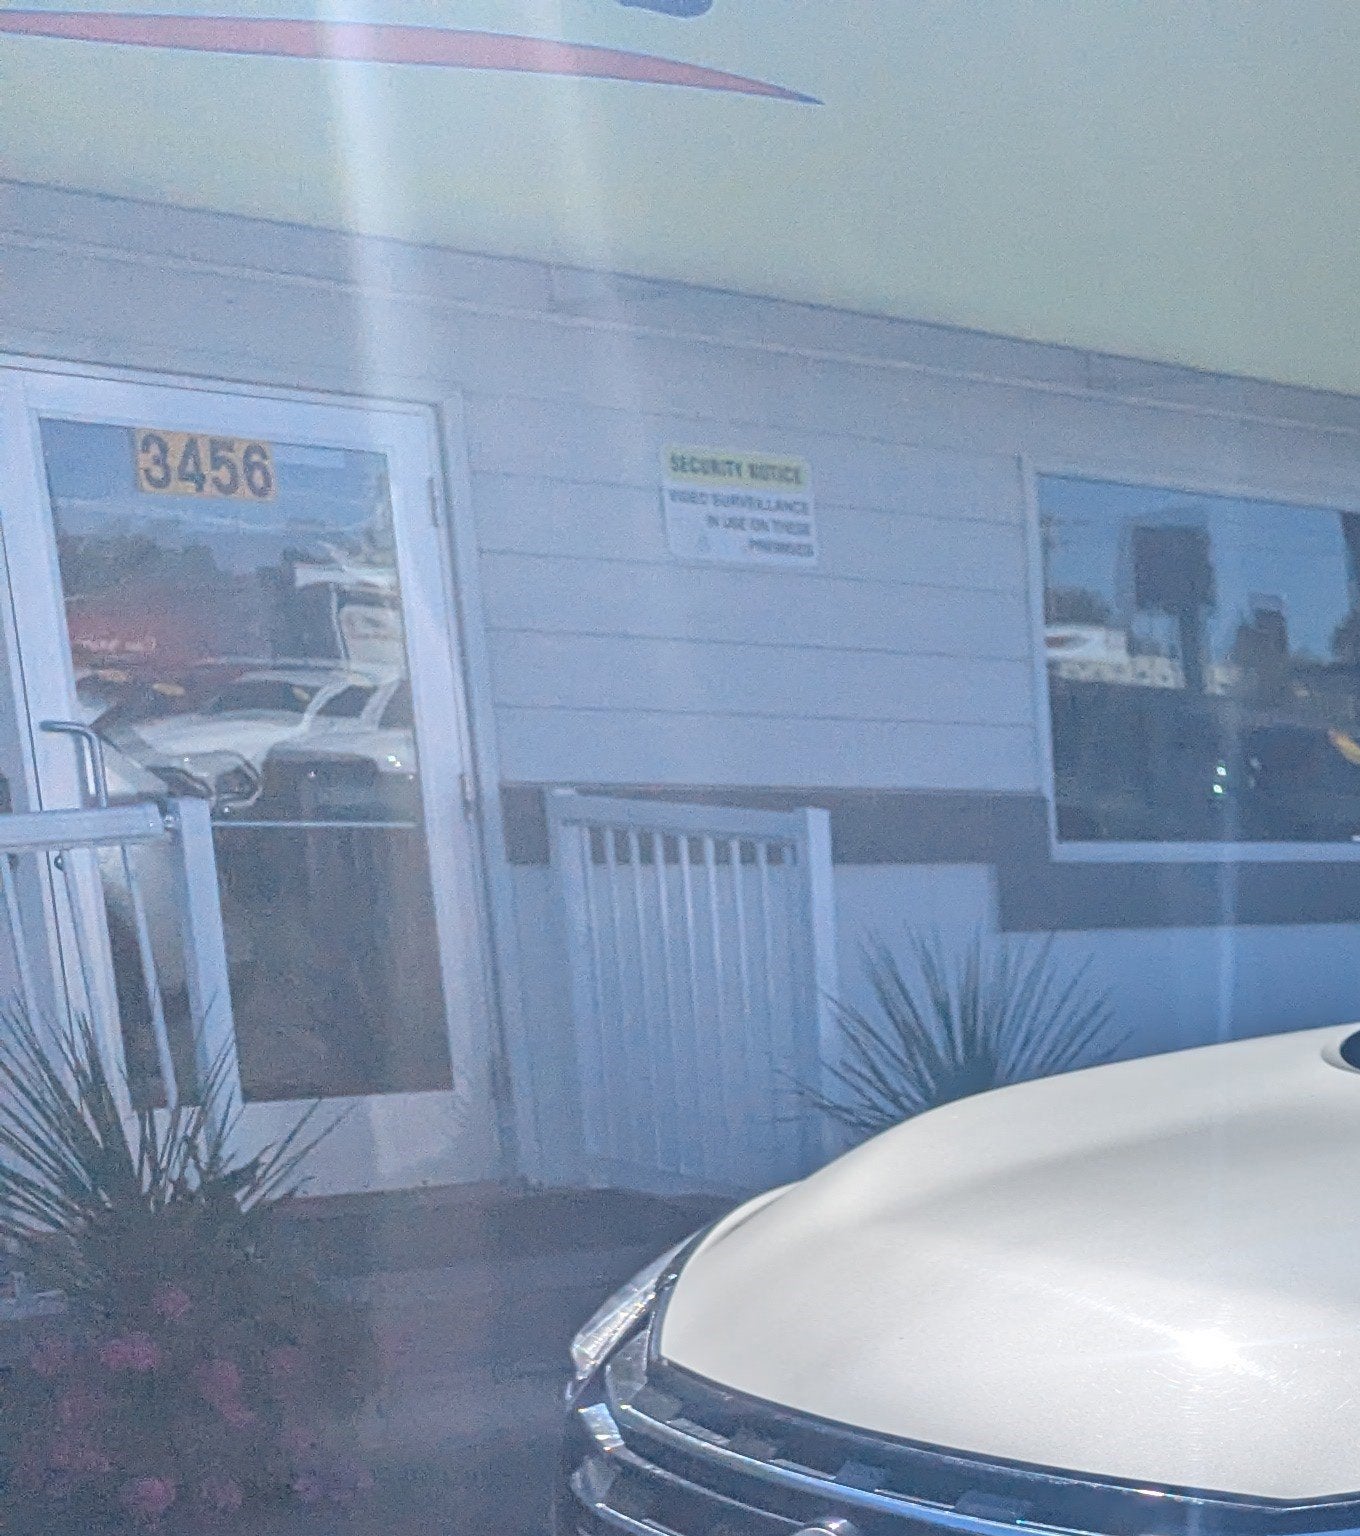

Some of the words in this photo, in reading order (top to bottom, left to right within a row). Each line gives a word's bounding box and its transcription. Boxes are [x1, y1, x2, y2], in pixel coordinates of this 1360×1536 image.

[141, 432, 273, 498] 3456
[670, 452, 743, 477] SECURITY
[748, 463, 803, 485] NOTICE
[712, 493, 809, 516] SURVEILLANCE
